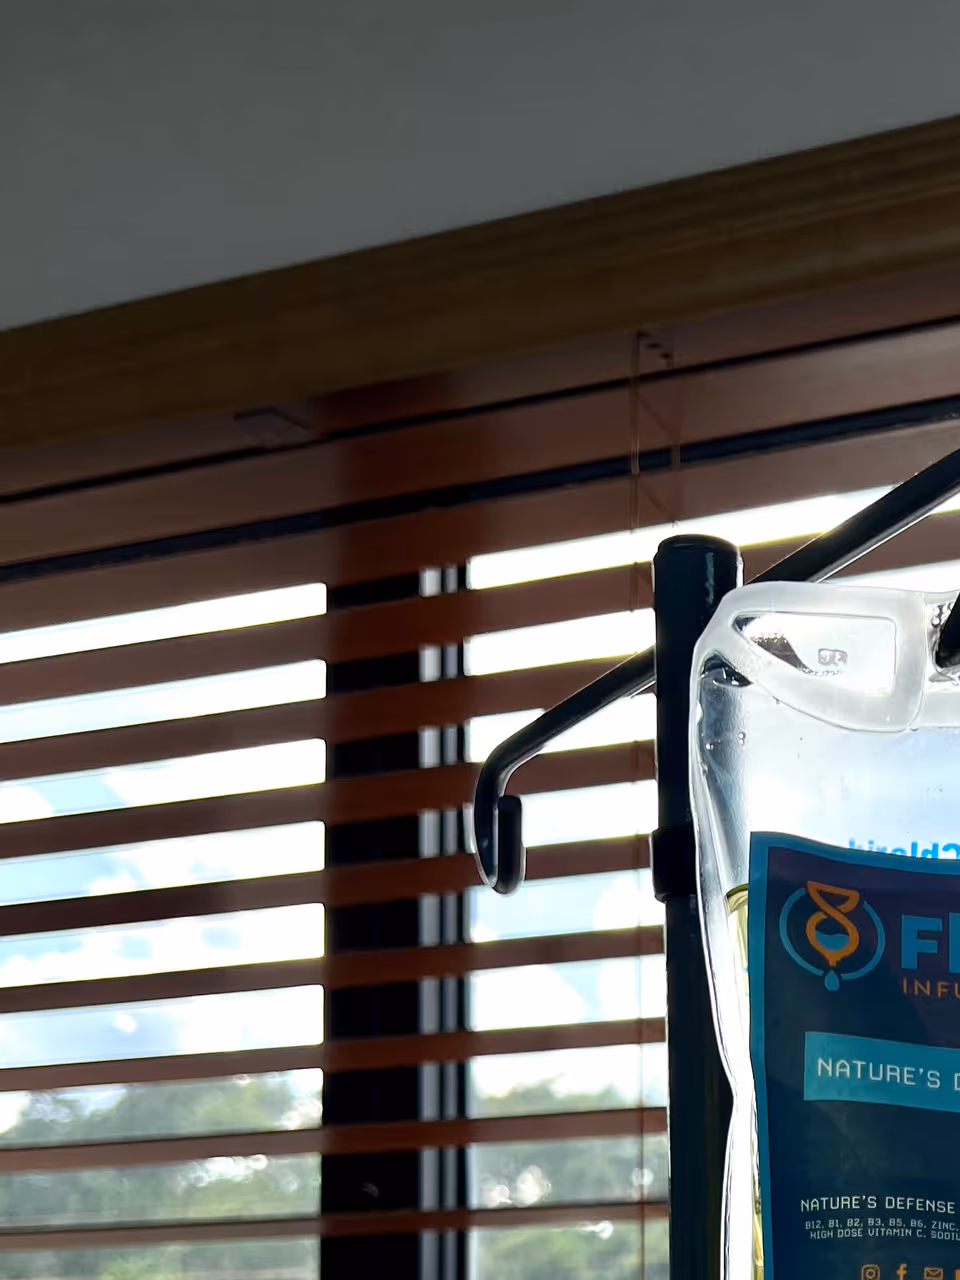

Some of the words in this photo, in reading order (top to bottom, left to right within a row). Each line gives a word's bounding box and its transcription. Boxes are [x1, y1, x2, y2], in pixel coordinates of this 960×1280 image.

[816, 1057, 941, 1090] NATURE'S
[800, 1195, 878, 1213] NATURE'S
[885, 1196, 957, 1215] DEFENSE
[810, 1230, 834, 1240] HIGH
[837, 1228, 863, 1239] DOSE
[867, 1228, 913, 1238] VITAMIN
[931, 1221, 959, 1232] ZINC,
